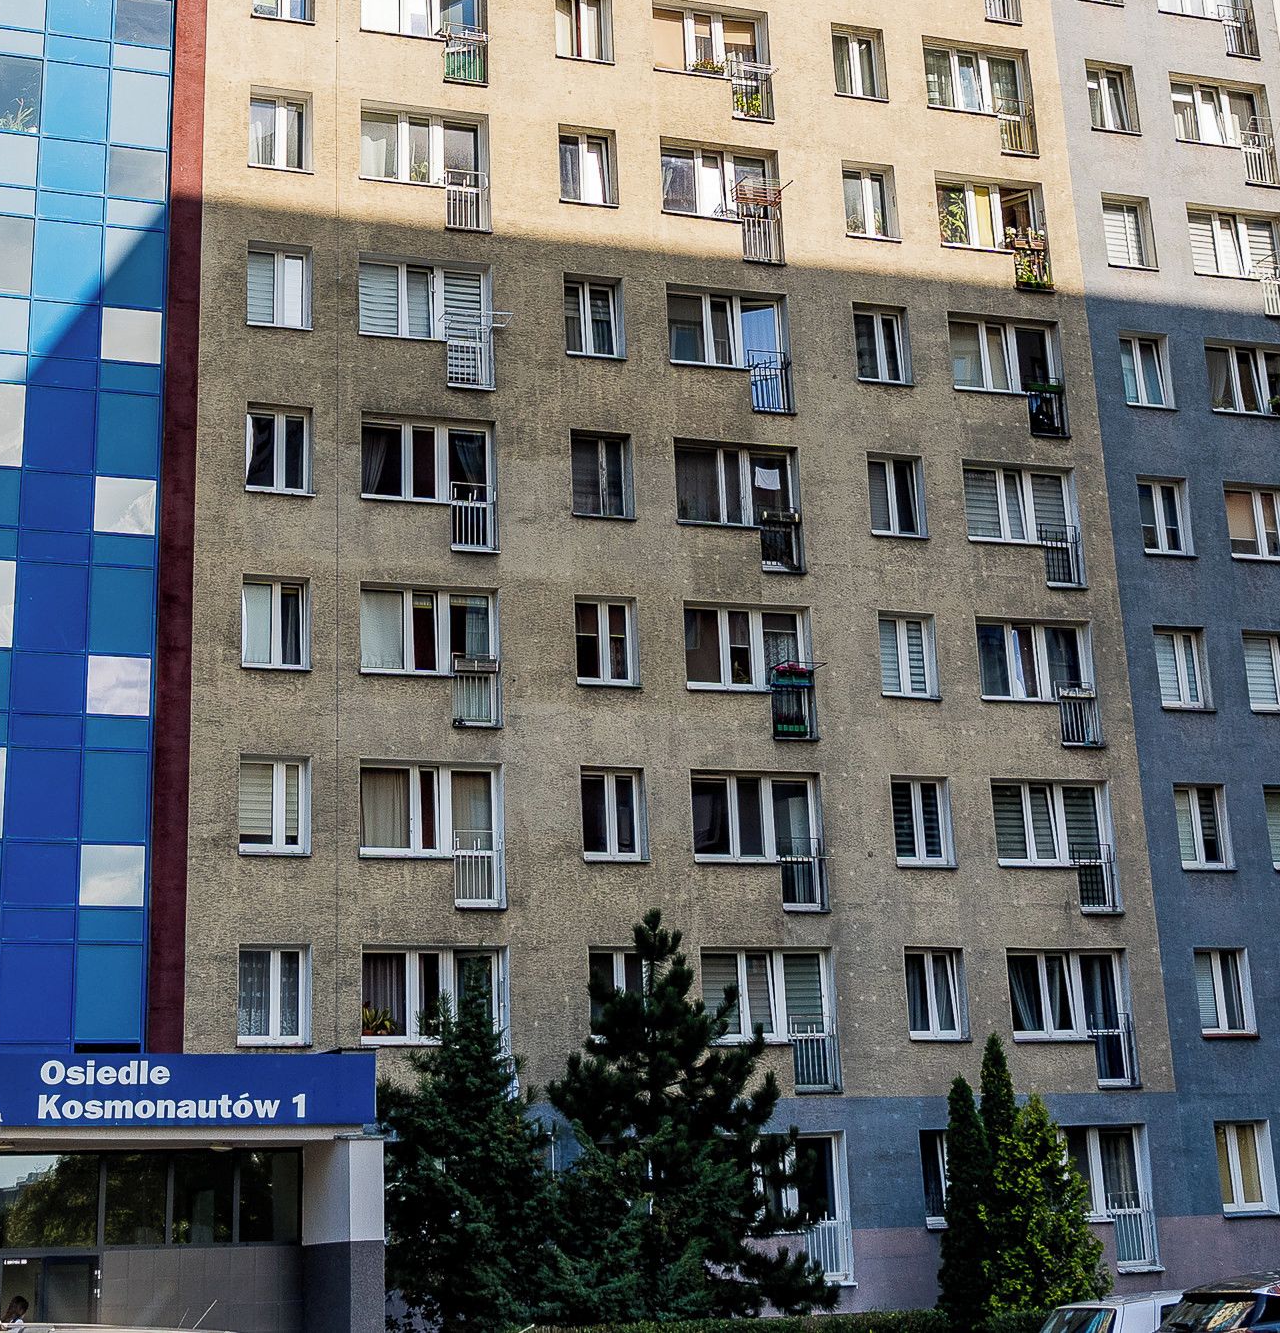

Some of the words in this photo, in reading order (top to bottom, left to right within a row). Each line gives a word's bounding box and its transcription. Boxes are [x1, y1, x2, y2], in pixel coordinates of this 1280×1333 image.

[40, 1060, 170, 1085] Osiedle
[38, 1093, 280, 1119] Kosmonautów
[292, 1093, 306, 1118] 1
